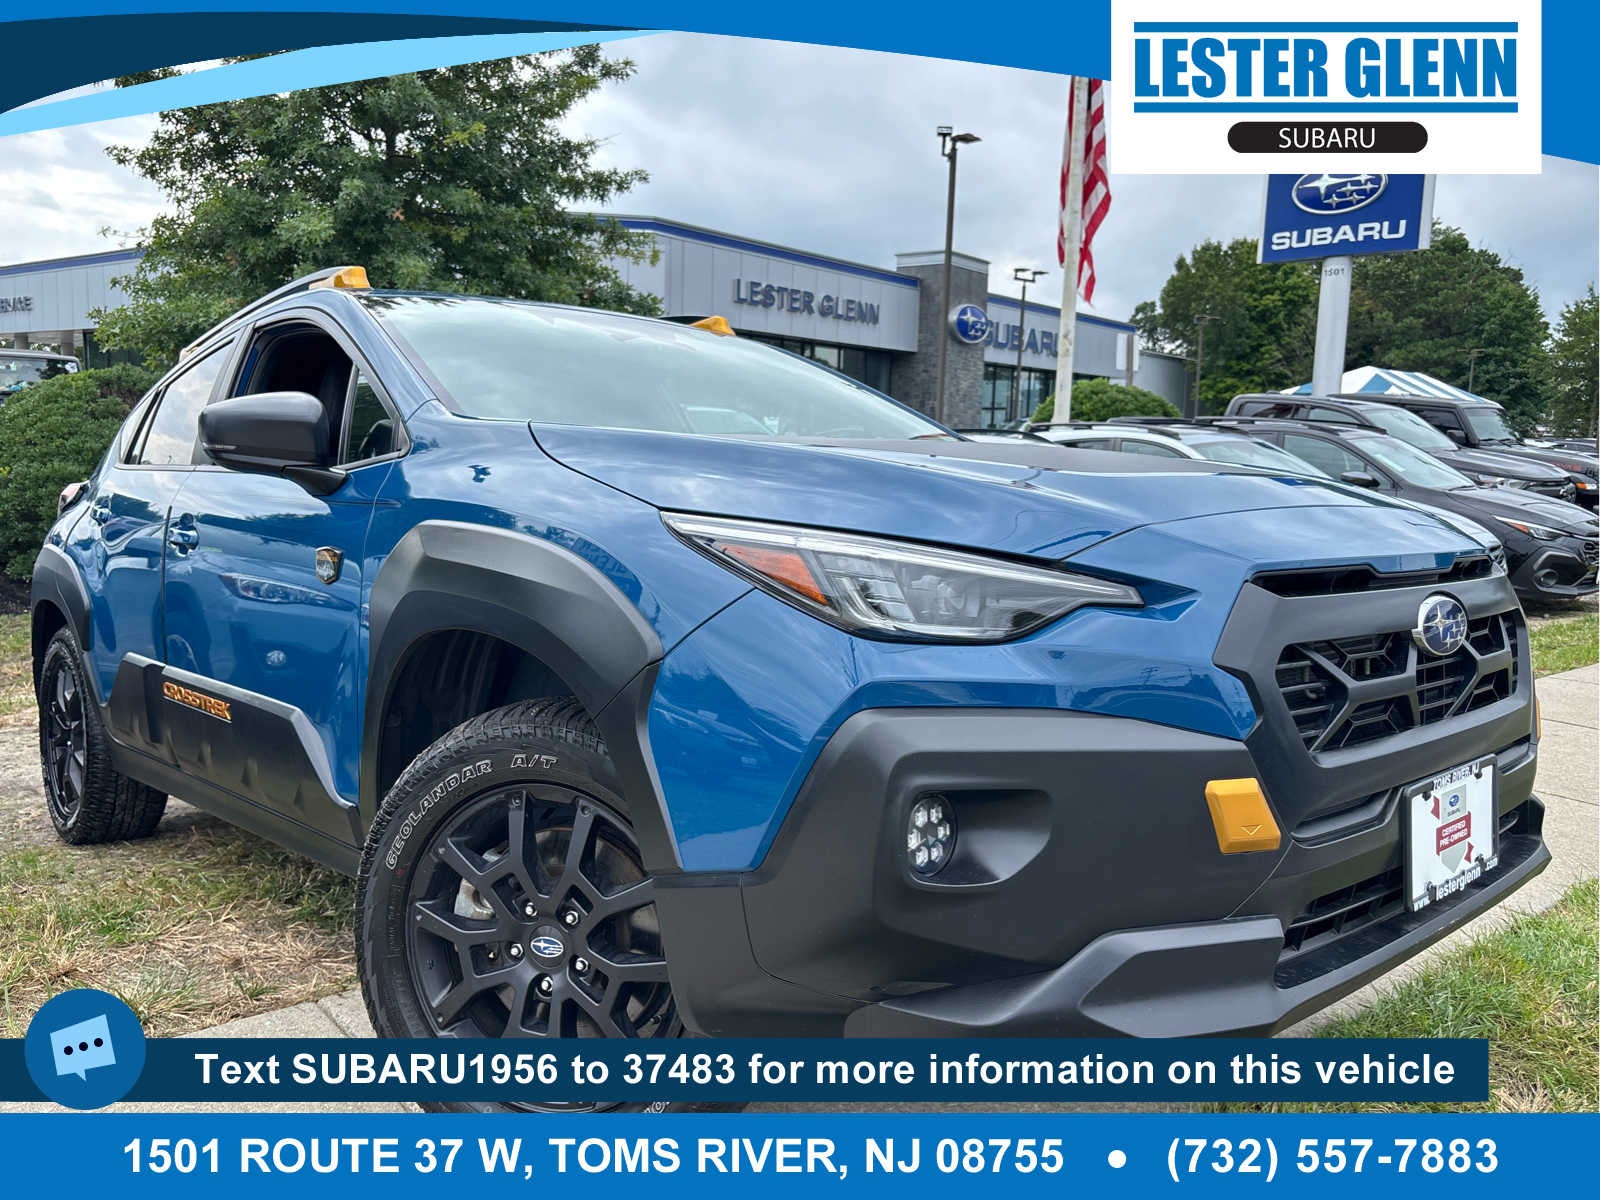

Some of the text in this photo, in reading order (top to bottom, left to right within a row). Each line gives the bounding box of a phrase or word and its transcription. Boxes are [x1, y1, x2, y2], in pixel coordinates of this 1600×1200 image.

[1271, 219, 1407, 251] SUBARU
[732, 278, 881, 325] LESTER GLENN
[162, 681, 231, 720] CROSSTREK
[1433, 773, 1451, 791] TOMS
[385, 753, 559, 870] GEOLANDAR A/T
[1436, 865, 1481, 901] lesterglenn
